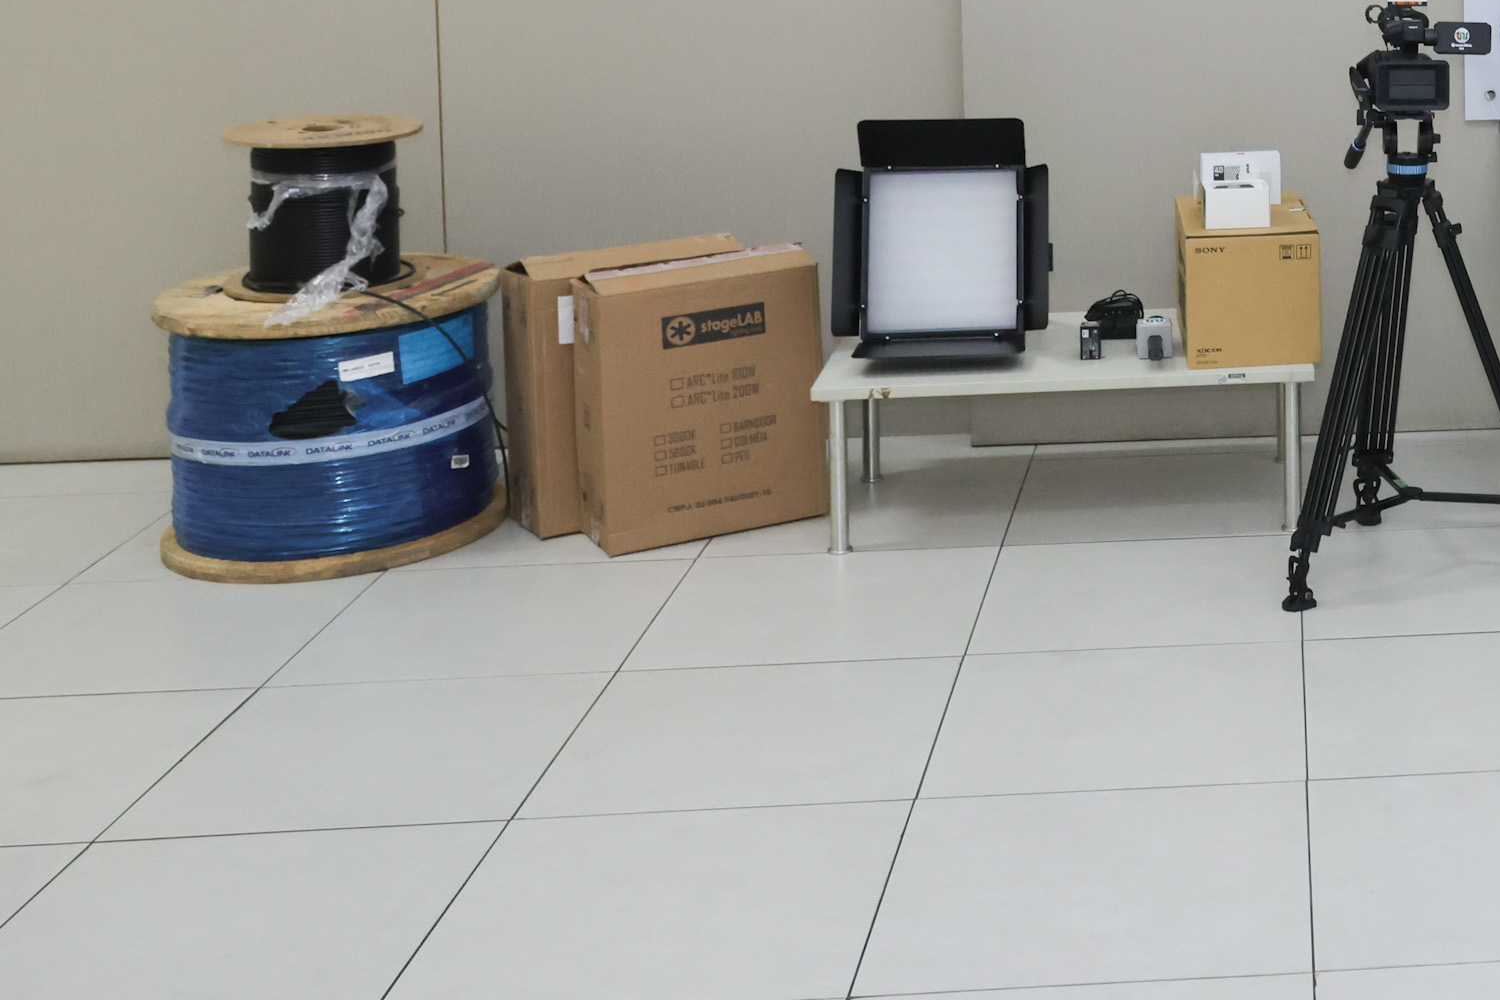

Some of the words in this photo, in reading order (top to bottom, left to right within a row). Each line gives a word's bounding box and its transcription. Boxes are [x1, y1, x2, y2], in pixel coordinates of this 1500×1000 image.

[1195, 246, 1225, 254] SONY
[701, 310, 763, 334] stageLAB
[733, 382, 760, 399] 200W
[247, 449, 291, 458] DATALINK
[305, 443, 353, 455] DATALINK
[367, 432, 411, 447] DATALINK
